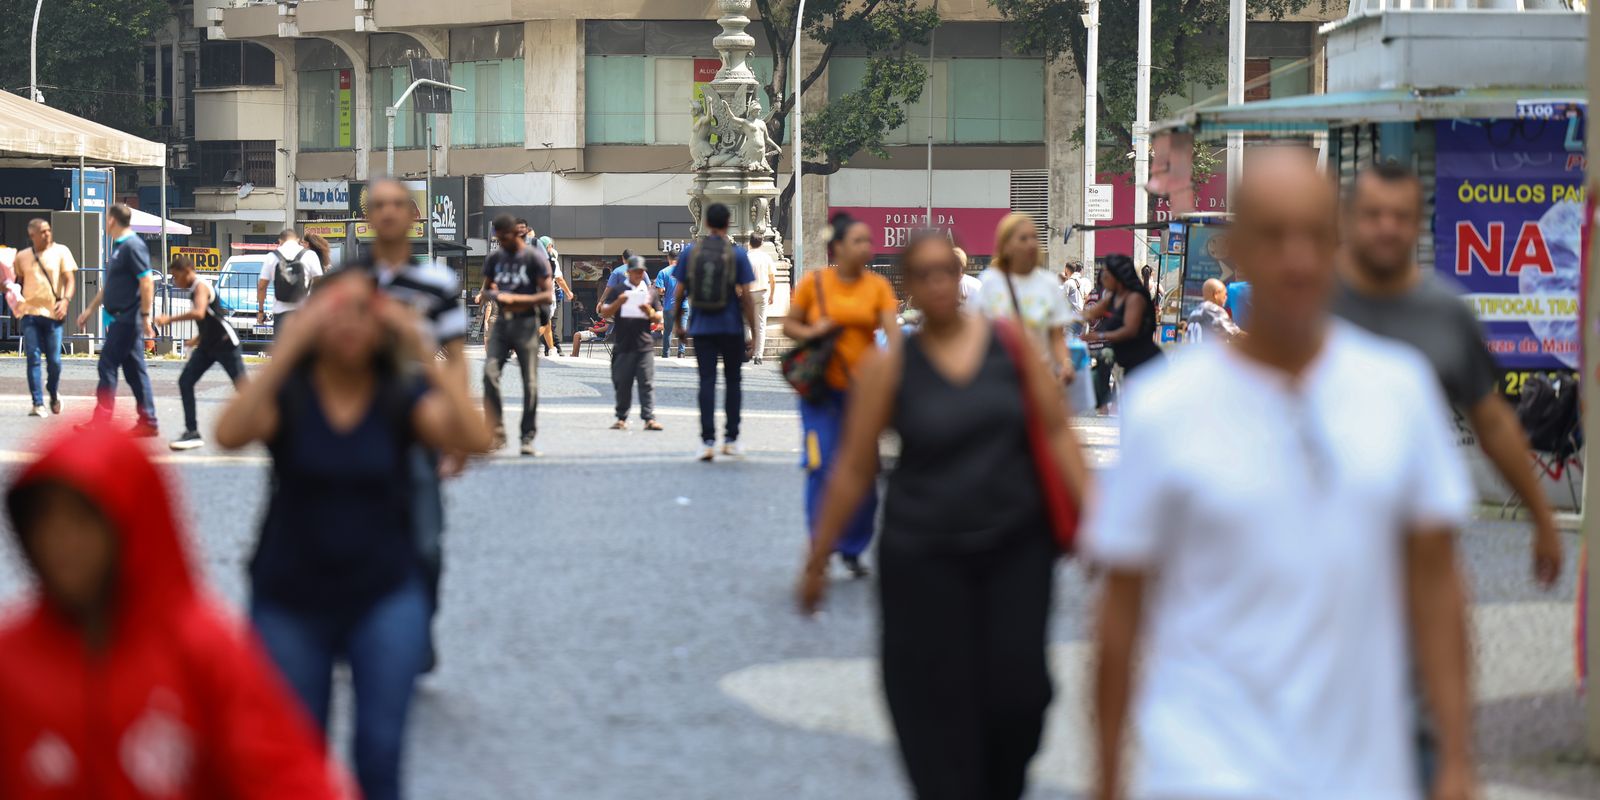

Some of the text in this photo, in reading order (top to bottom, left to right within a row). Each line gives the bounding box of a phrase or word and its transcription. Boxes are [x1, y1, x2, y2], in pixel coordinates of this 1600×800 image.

[335, 188, 349, 202] Cari
[1457, 180, 1545, 203] ÓCULOS
[886, 214, 954, 224] POINT DA
[883, 226, 955, 247] BELA
[1456, 221, 1556, 276] NA
[1471, 297, 1544, 315] LTIFOCAL
